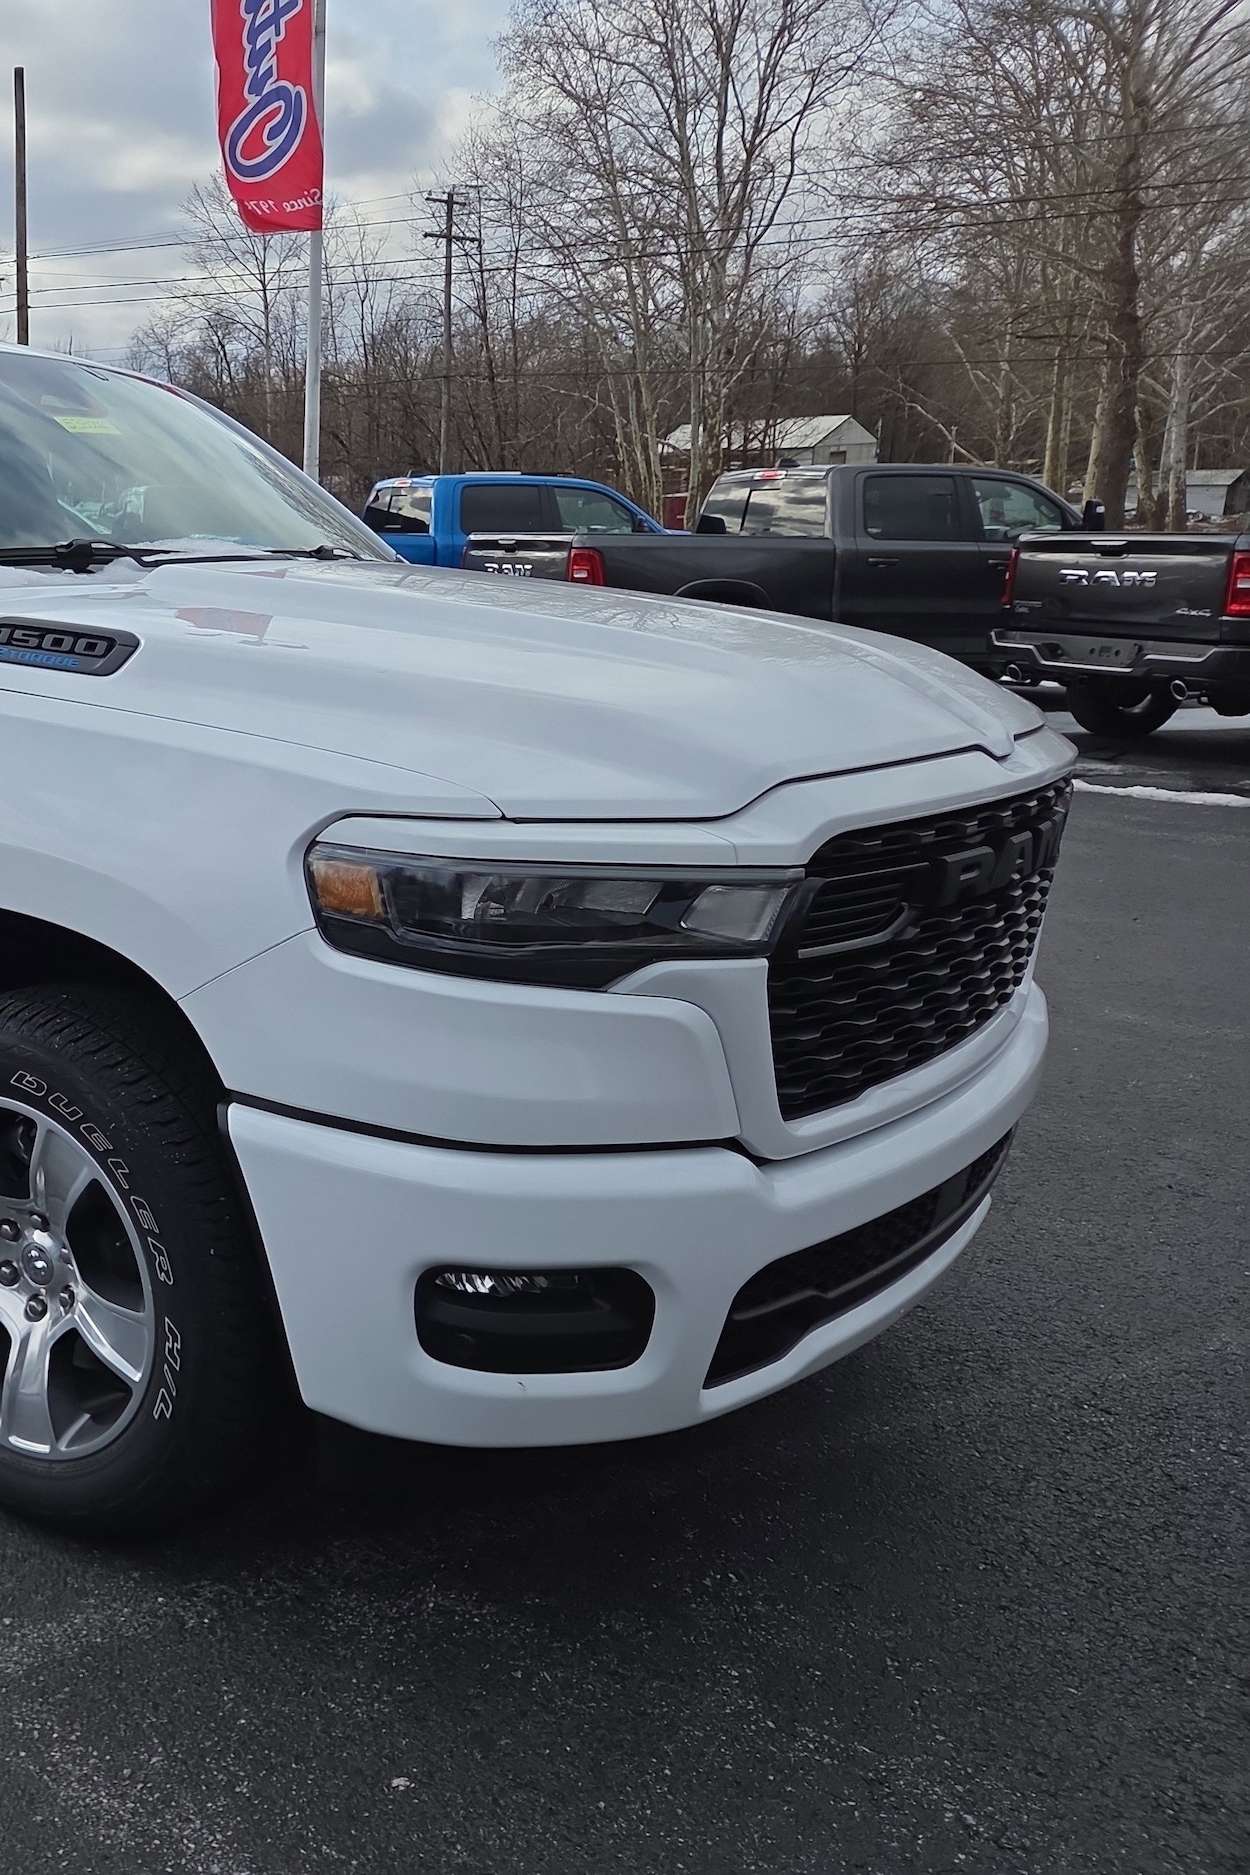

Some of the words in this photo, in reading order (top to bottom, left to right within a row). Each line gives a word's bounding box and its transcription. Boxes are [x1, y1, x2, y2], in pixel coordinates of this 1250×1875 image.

[1058, 569, 1158, 587] RAM
[940, 811, 1066, 904] RAM
[10, 1070, 174, 1286] DUELER
